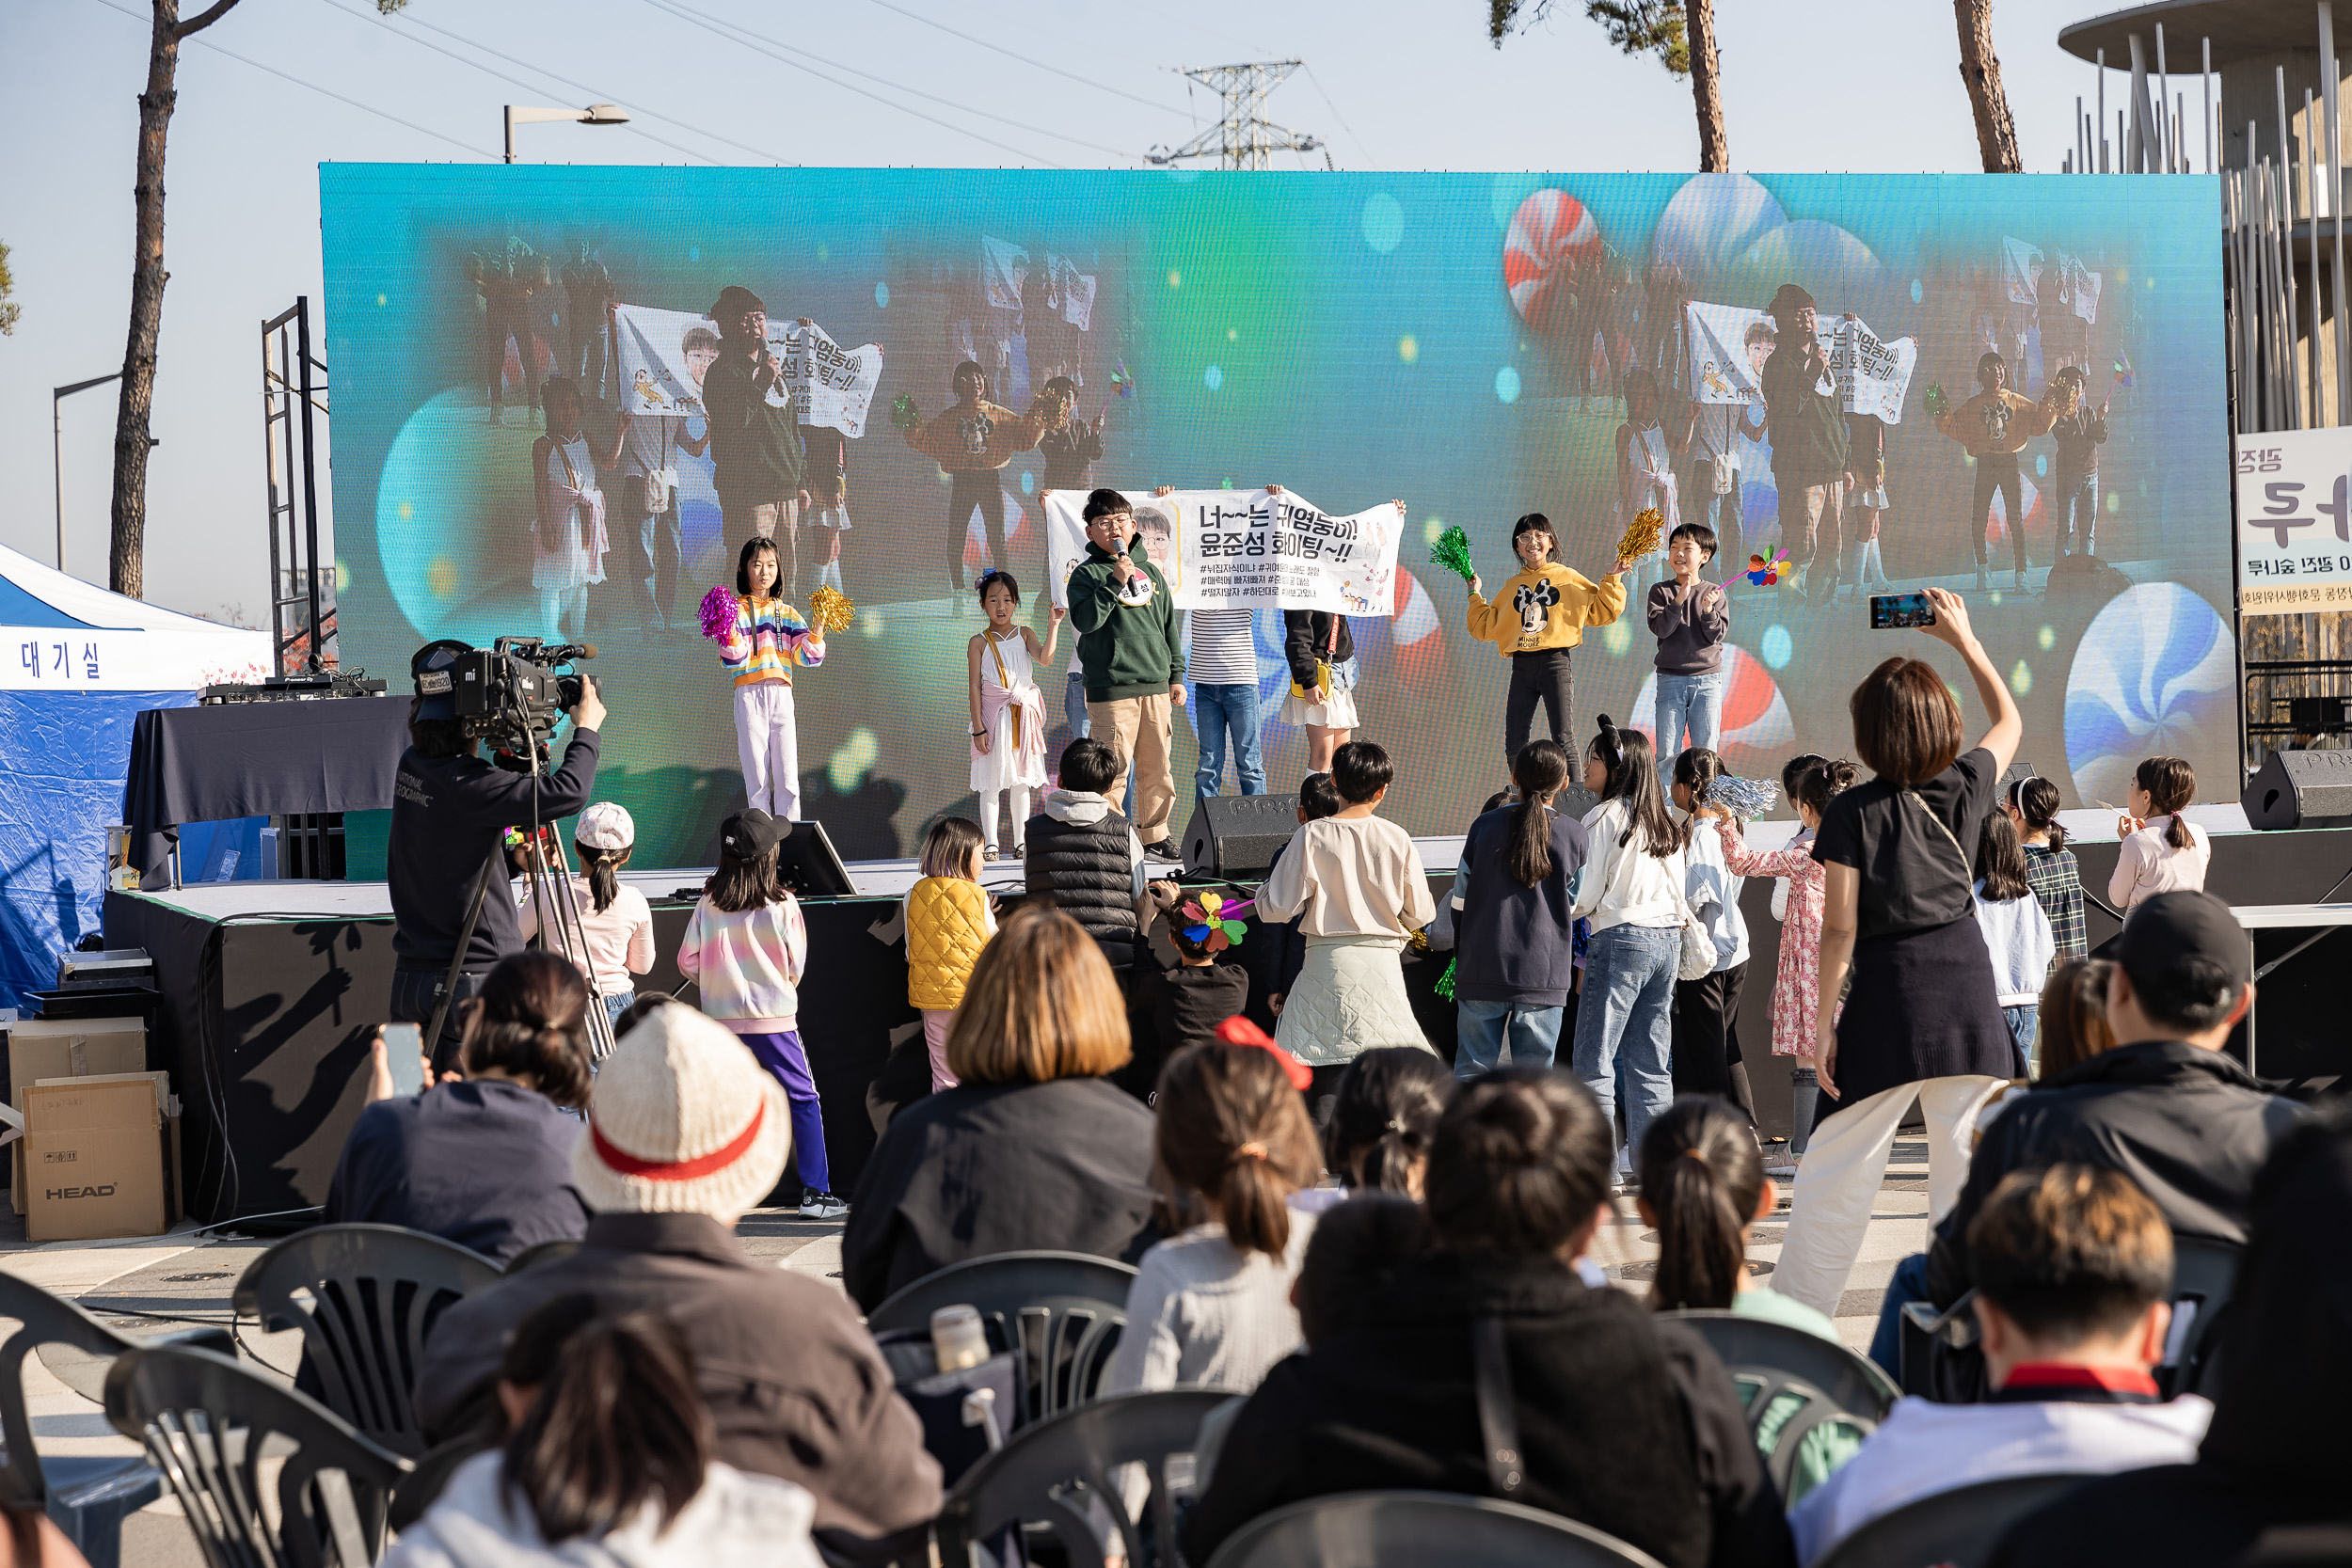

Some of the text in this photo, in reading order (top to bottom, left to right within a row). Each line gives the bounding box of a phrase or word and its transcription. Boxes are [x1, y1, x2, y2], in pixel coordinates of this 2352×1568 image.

[1200, 503, 1359, 541] 너~~는 귀염둥이!
[1200, 531, 1265, 558] 윤준성
[1200, 576, 1232, 586] #매력에
[1233, 575, 1266, 585] 빠져빠져
[1120, 583, 1150, 598] 윤성
[1242, 586, 1279, 596] #하던대로
[22, 641, 100, 679] 대기실
[46, 1184, 116, 1200] HEAD
